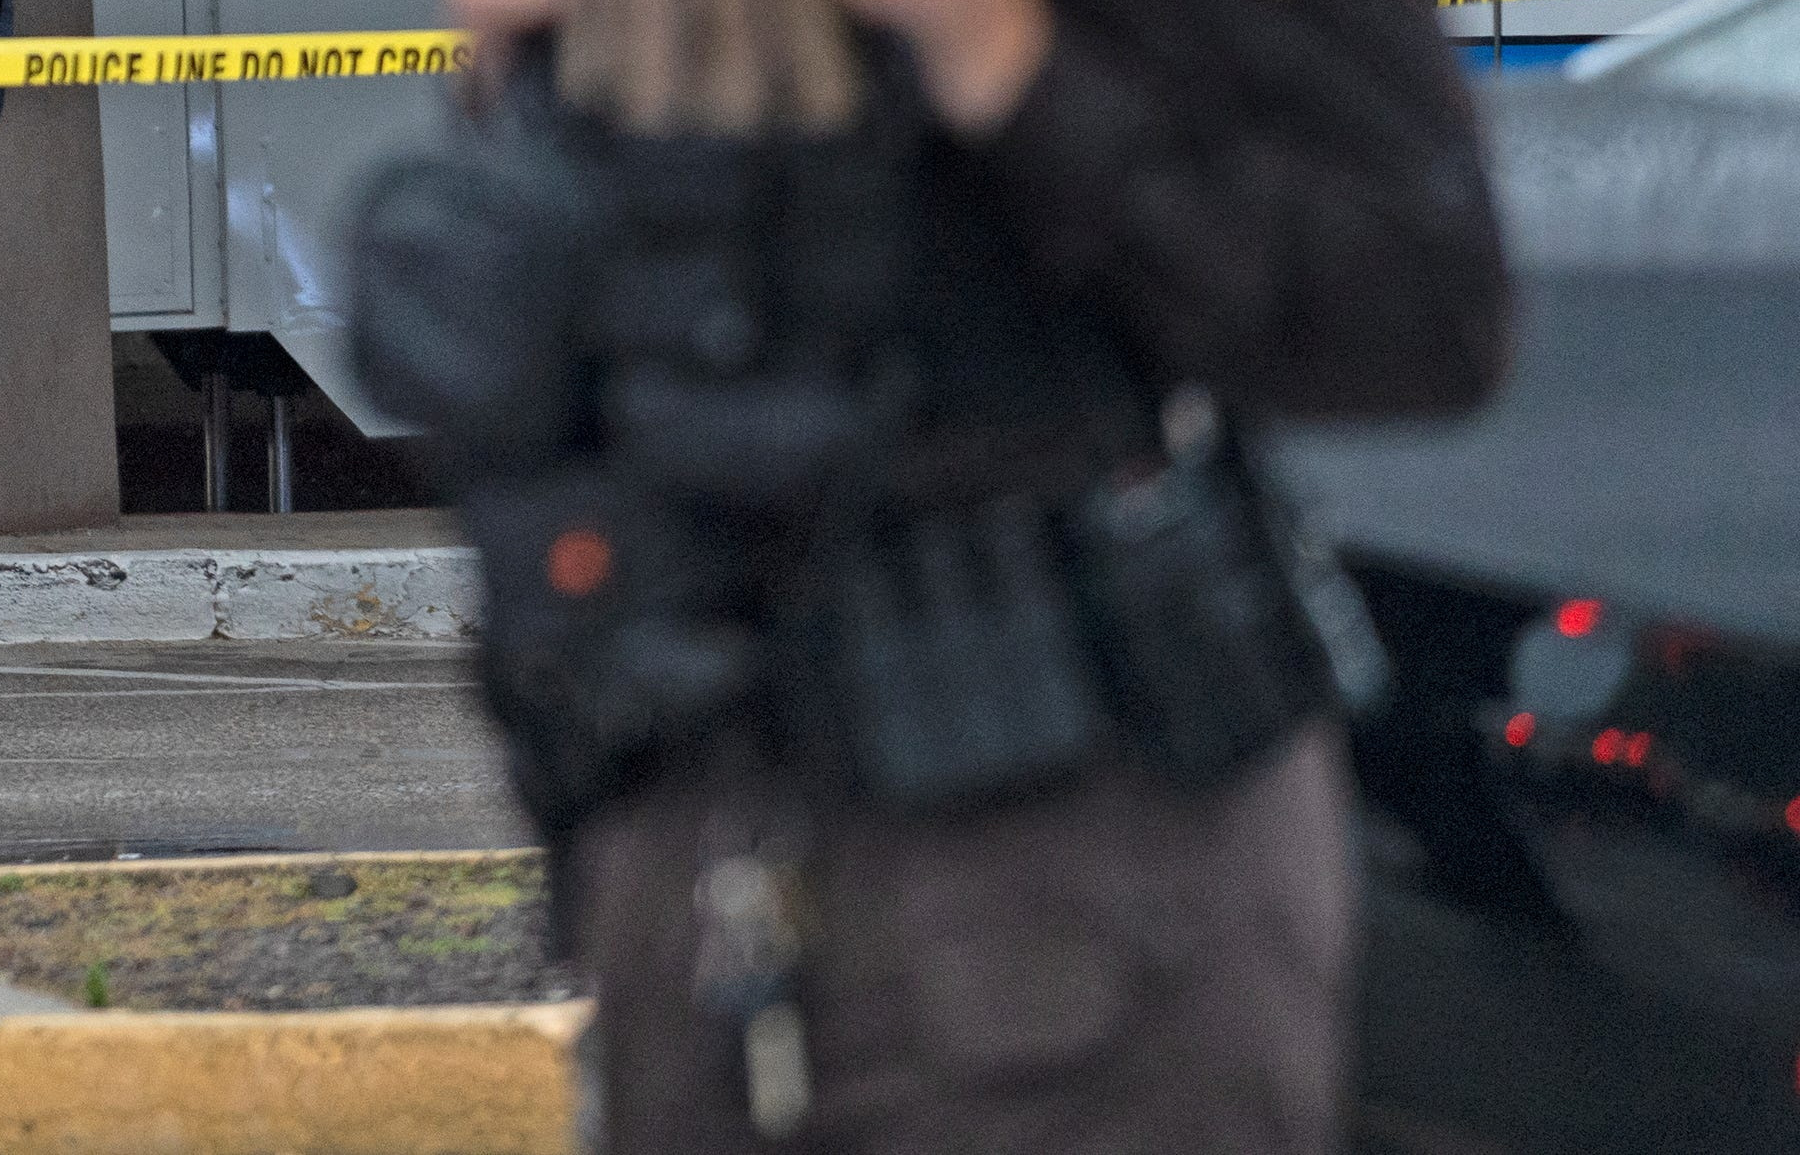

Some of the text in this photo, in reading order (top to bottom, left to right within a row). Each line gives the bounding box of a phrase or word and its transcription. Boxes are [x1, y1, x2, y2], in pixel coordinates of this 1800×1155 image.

[25, 46, 469, 84] POLICE LINE DO NOT CROS
